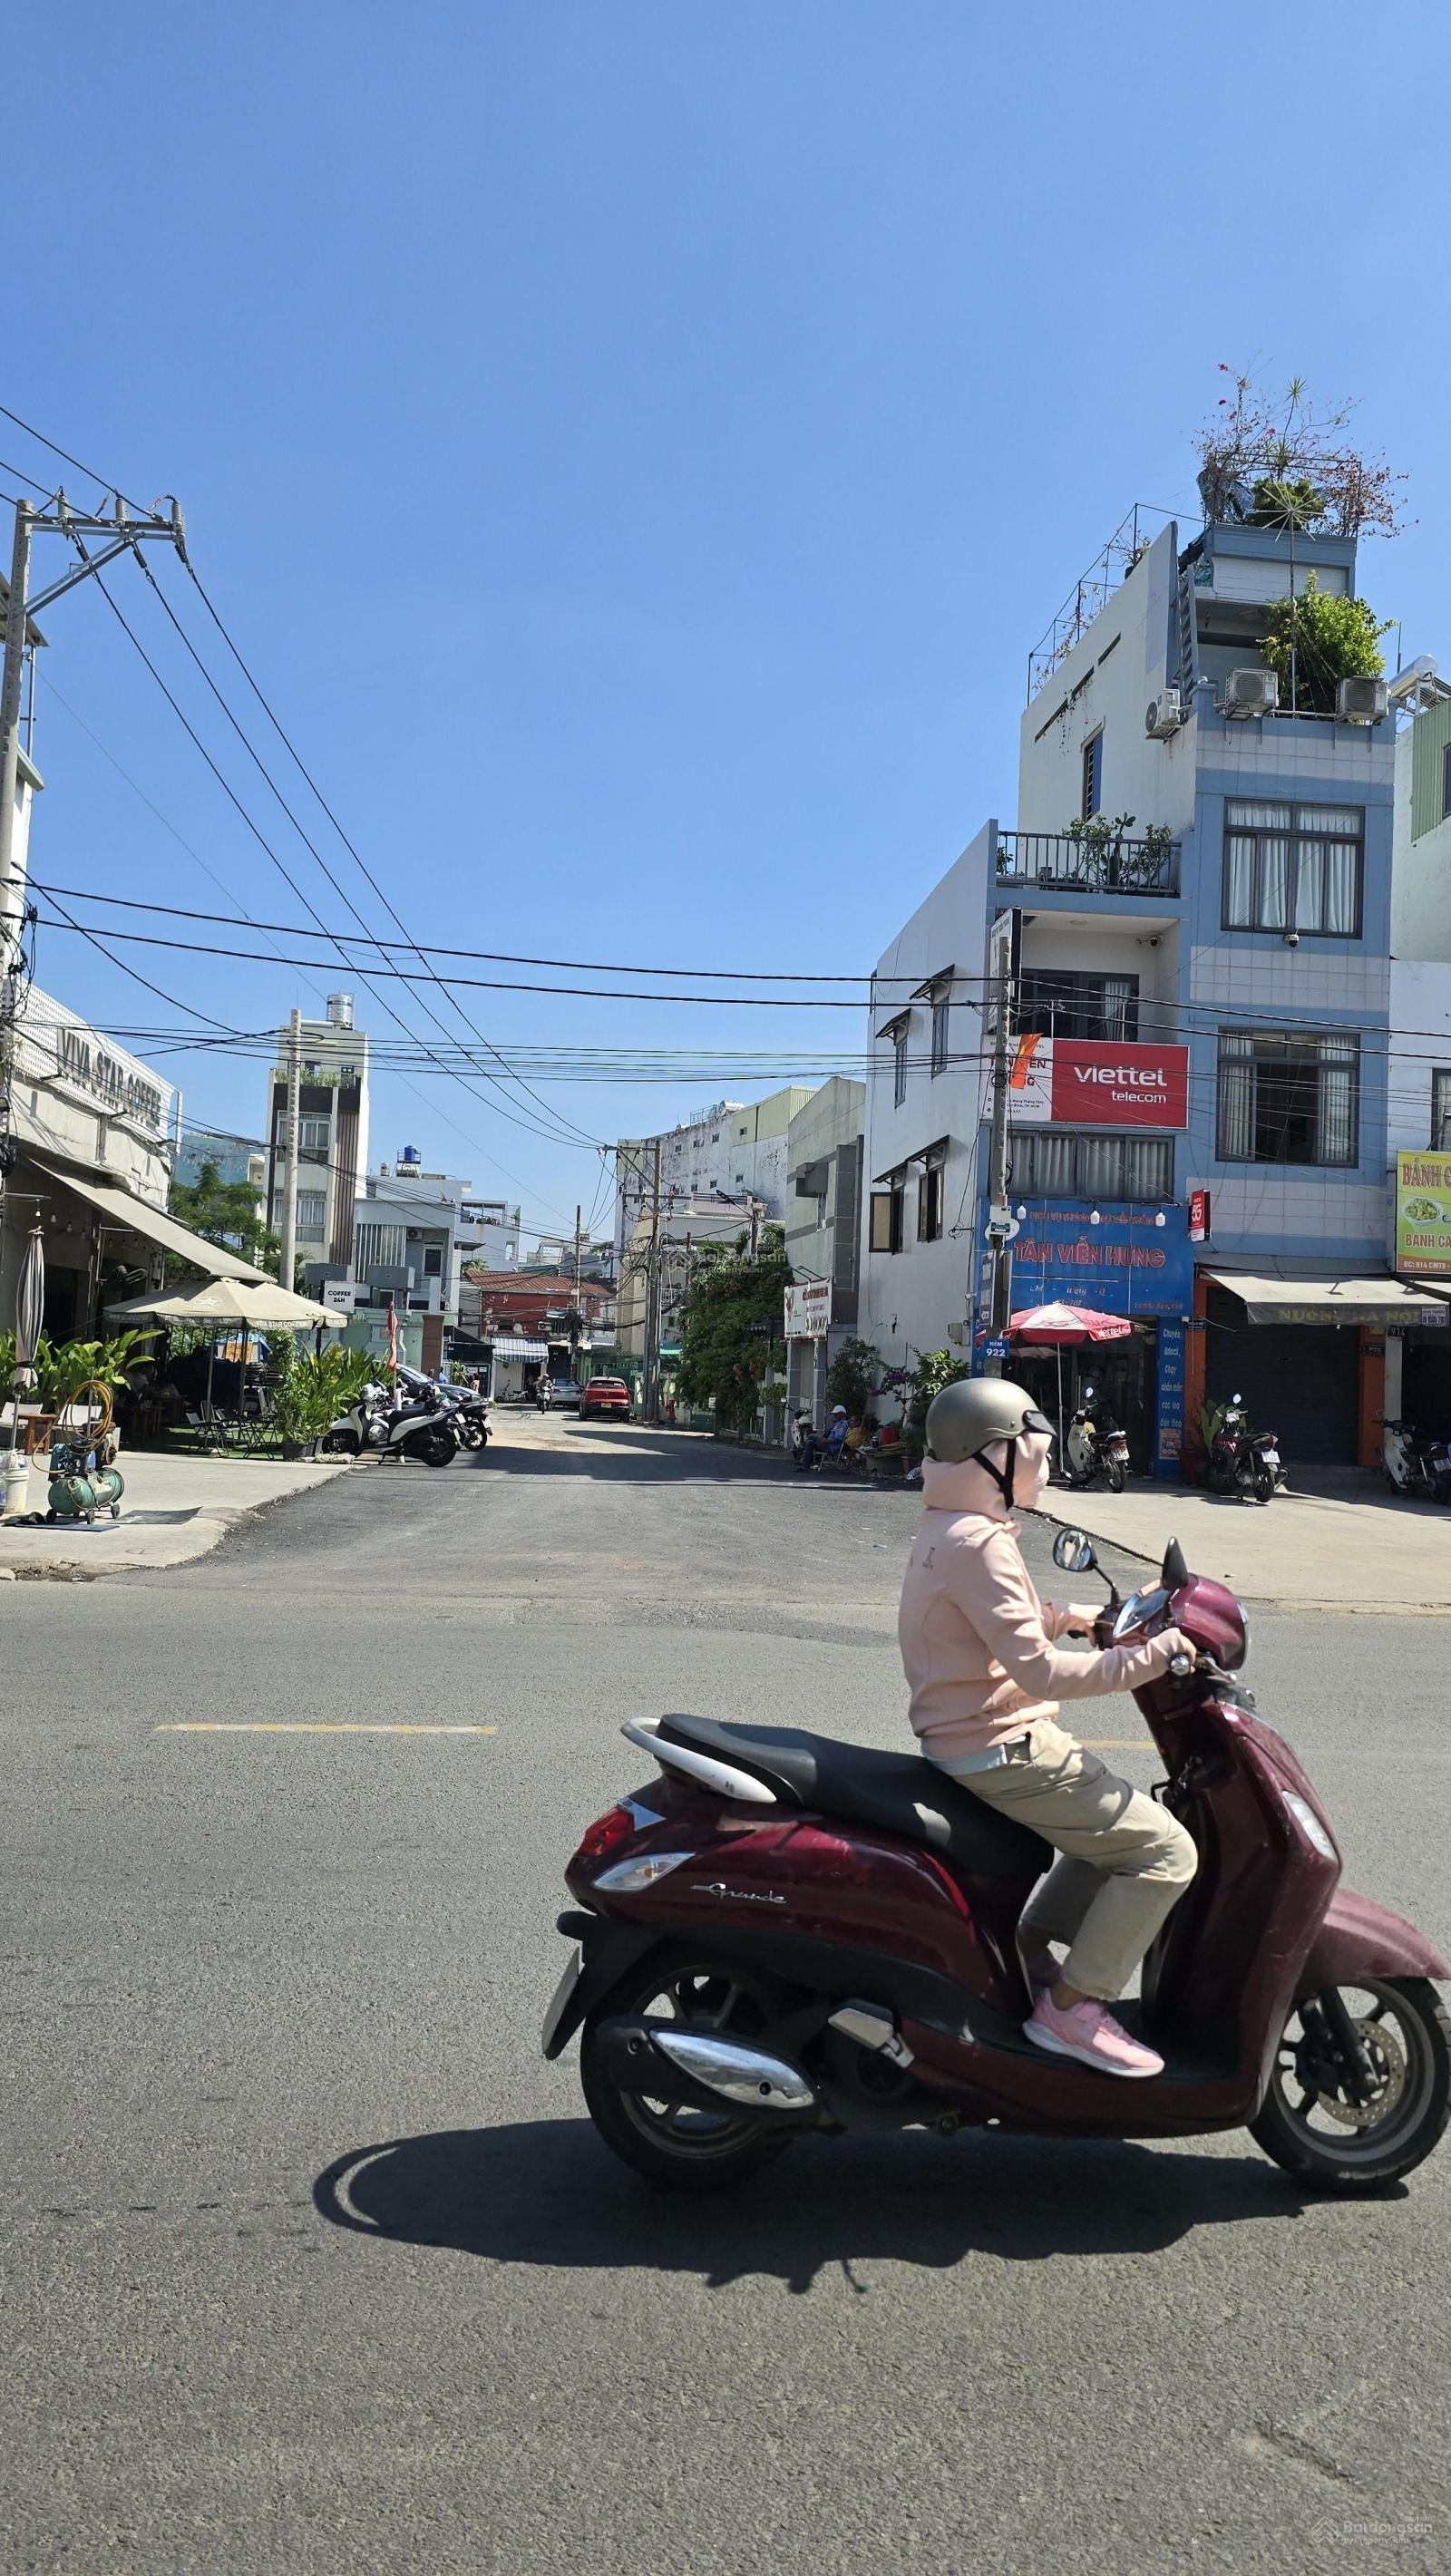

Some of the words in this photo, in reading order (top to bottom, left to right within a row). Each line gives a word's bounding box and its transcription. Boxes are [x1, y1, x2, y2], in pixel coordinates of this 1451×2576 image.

[57, 1027, 91, 1079] VIVA
[95, 1050, 123, 1098] STAR
[1111, 1090, 1166, 1103] telecom
[1015, 1237, 1054, 1263] TÂN
[1057, 1235, 1103, 1266] VIỄN
[986, 1348, 1006, 1357] 922
[689, 1882, 787, 1904] Grande
